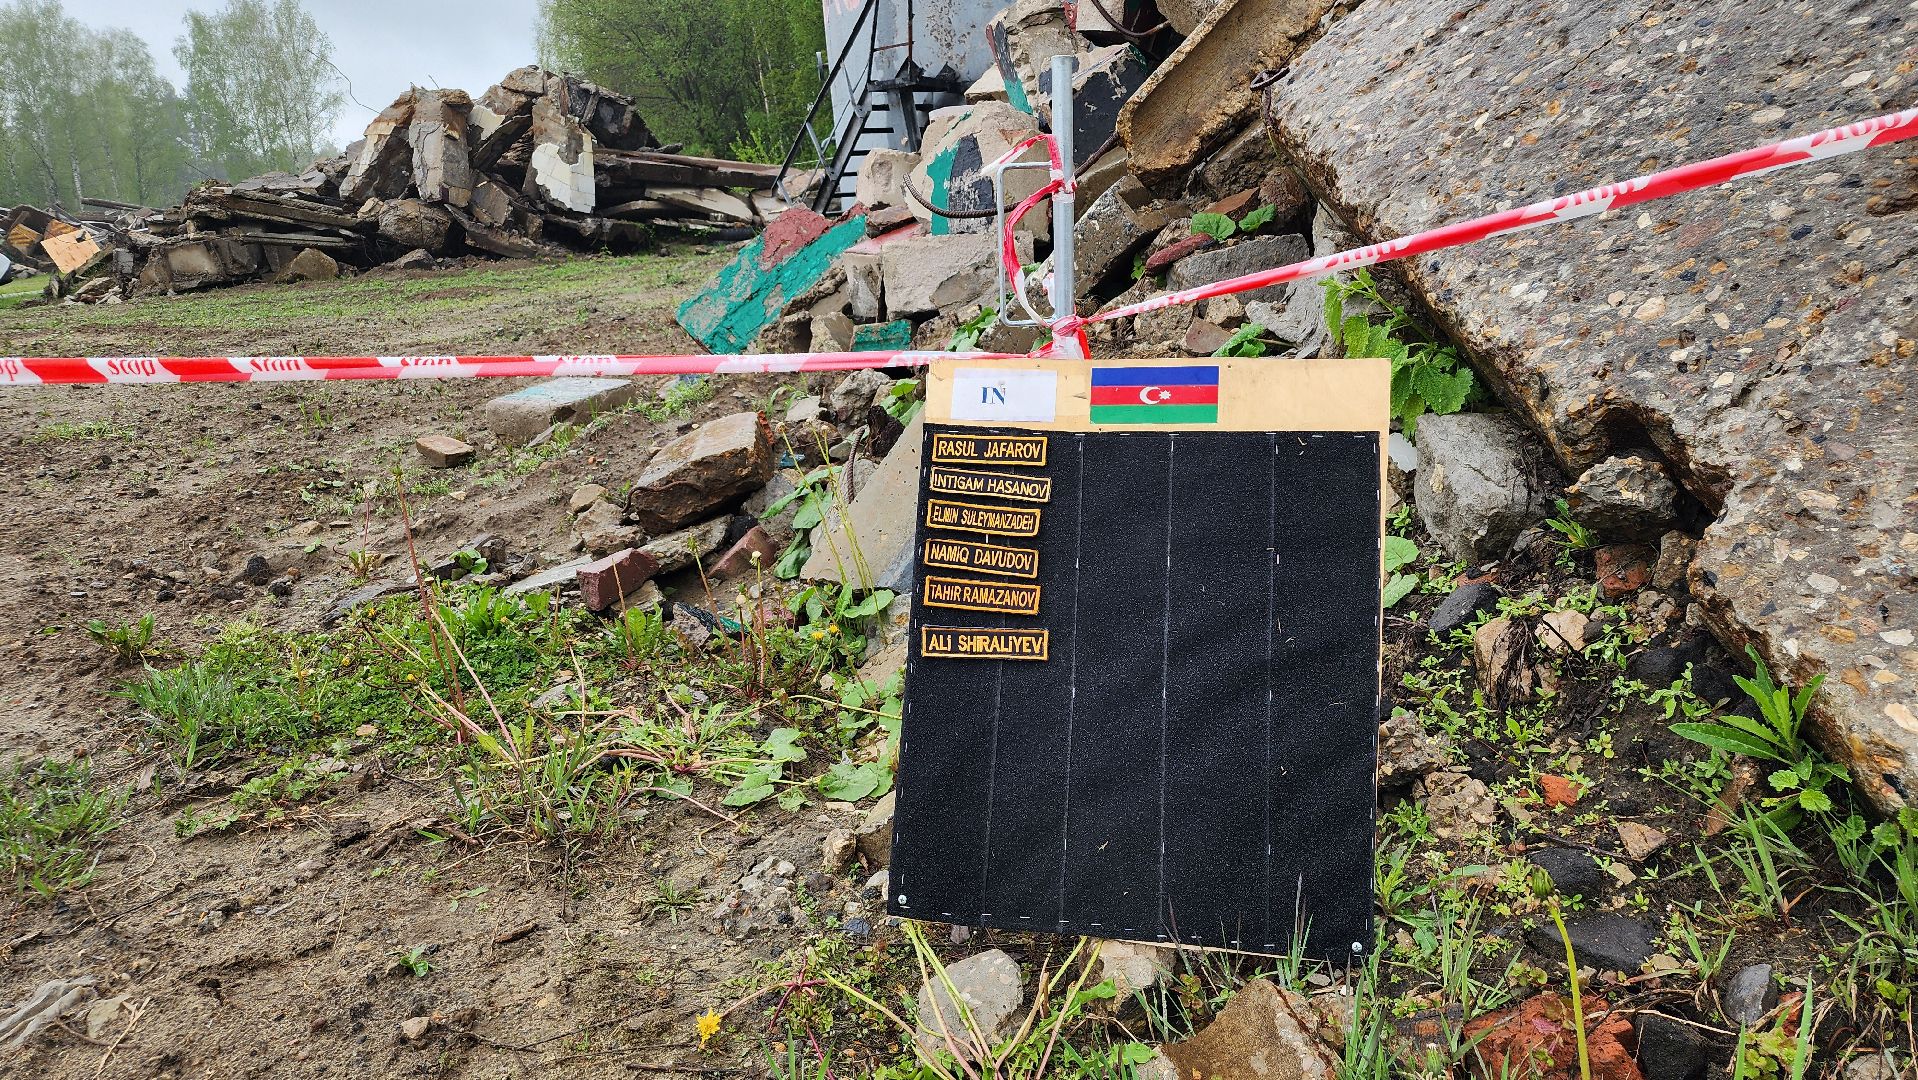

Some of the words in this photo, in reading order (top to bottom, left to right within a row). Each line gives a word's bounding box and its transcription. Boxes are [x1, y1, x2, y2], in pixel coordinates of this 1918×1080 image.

[938, 440, 978, 457] RASUL
[983, 442, 1041, 459] JAFAROV
[934, 474, 984, 491] INTIGAM
[987, 478, 1048, 497] HASANOV
[961, 509, 1034, 531] SULEYMANZADEH
[974, 548, 1033, 571] DAVUDOV
[930, 584, 961, 602] TAHIR
[963, 586, 1036, 608] RAMAZANOV
